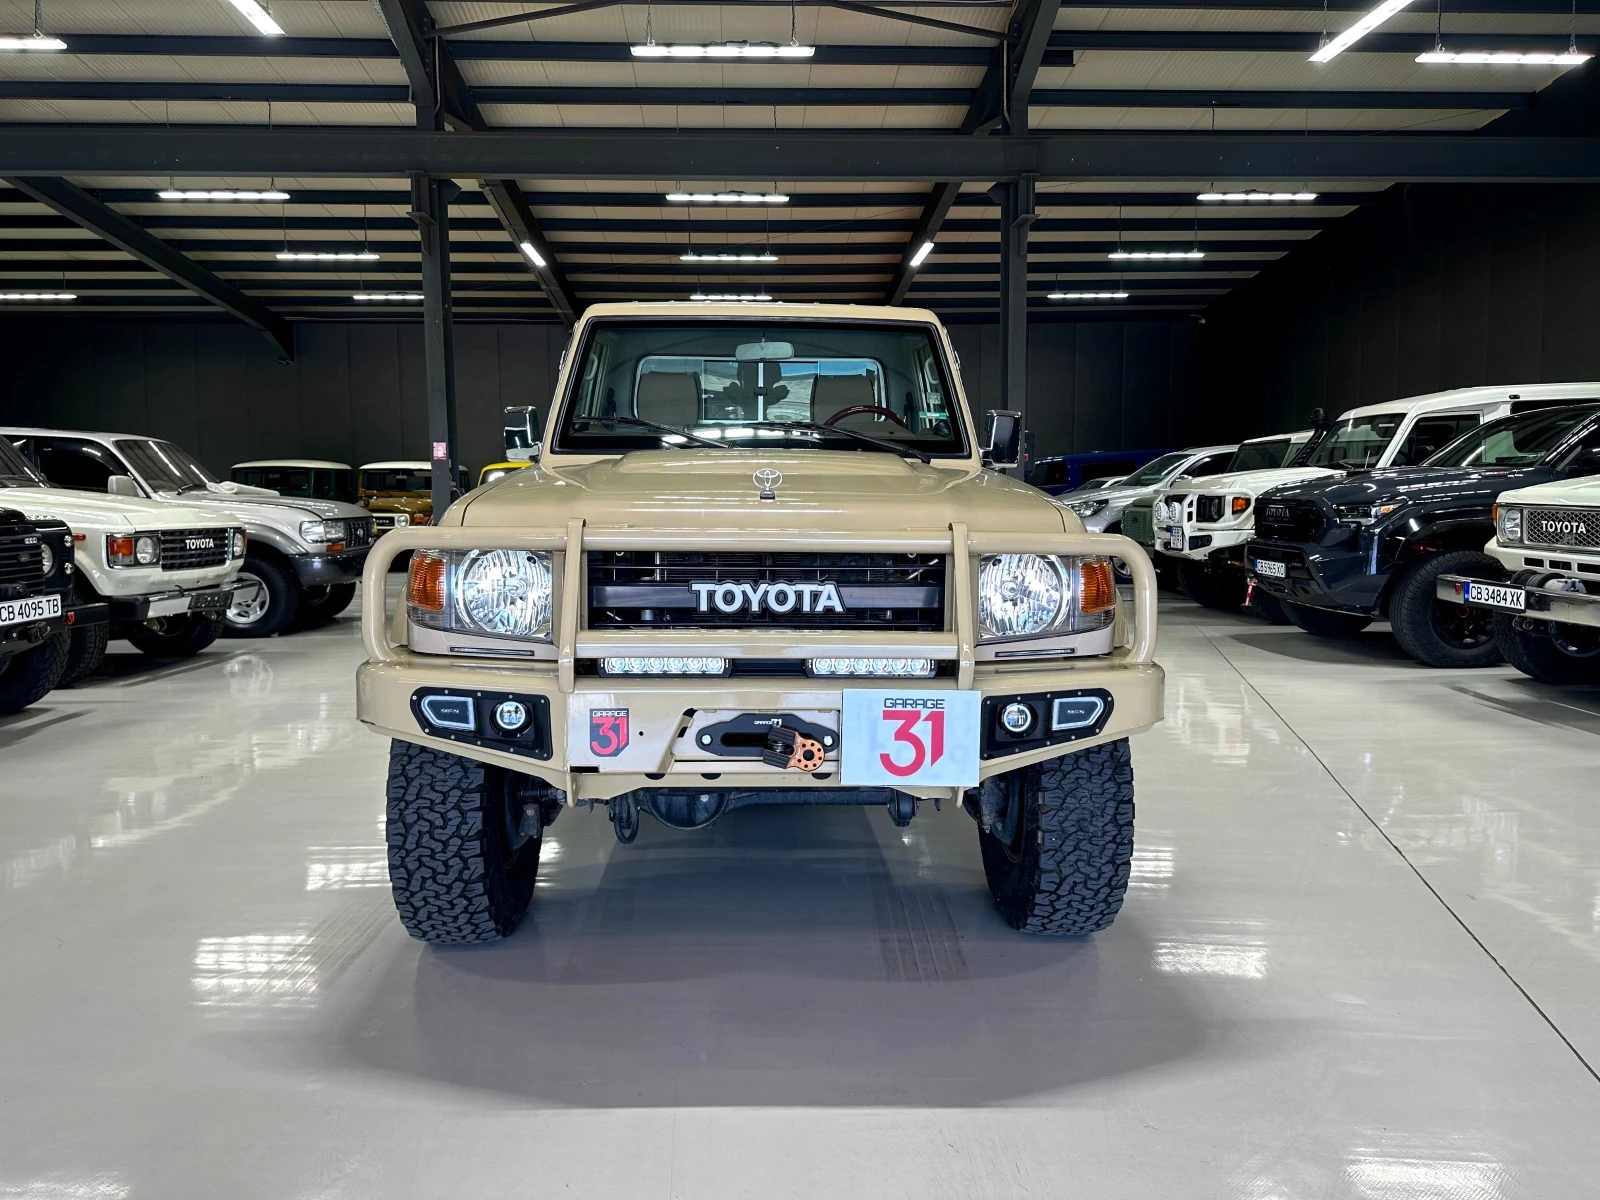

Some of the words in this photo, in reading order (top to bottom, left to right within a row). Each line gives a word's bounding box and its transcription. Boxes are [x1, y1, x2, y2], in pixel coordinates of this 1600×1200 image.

[1541, 520, 1587, 534] TOYOTA
[185, 538, 214, 549] TOYOTA
[690, 581, 845, 613] TOYOTA
[1470, 585, 1482, 601] CB
[1484, 587, 1508, 605] 3484
[1509, 590, 1522, 607] XK
[0, 605, 15, 622] CB
[17, 600, 44, 619] 4095
[46, 598, 60, 615] TB
[884, 697, 945, 710] GARAGE
[591, 717, 628, 755] 31
[880, 709, 945, 777] 31
